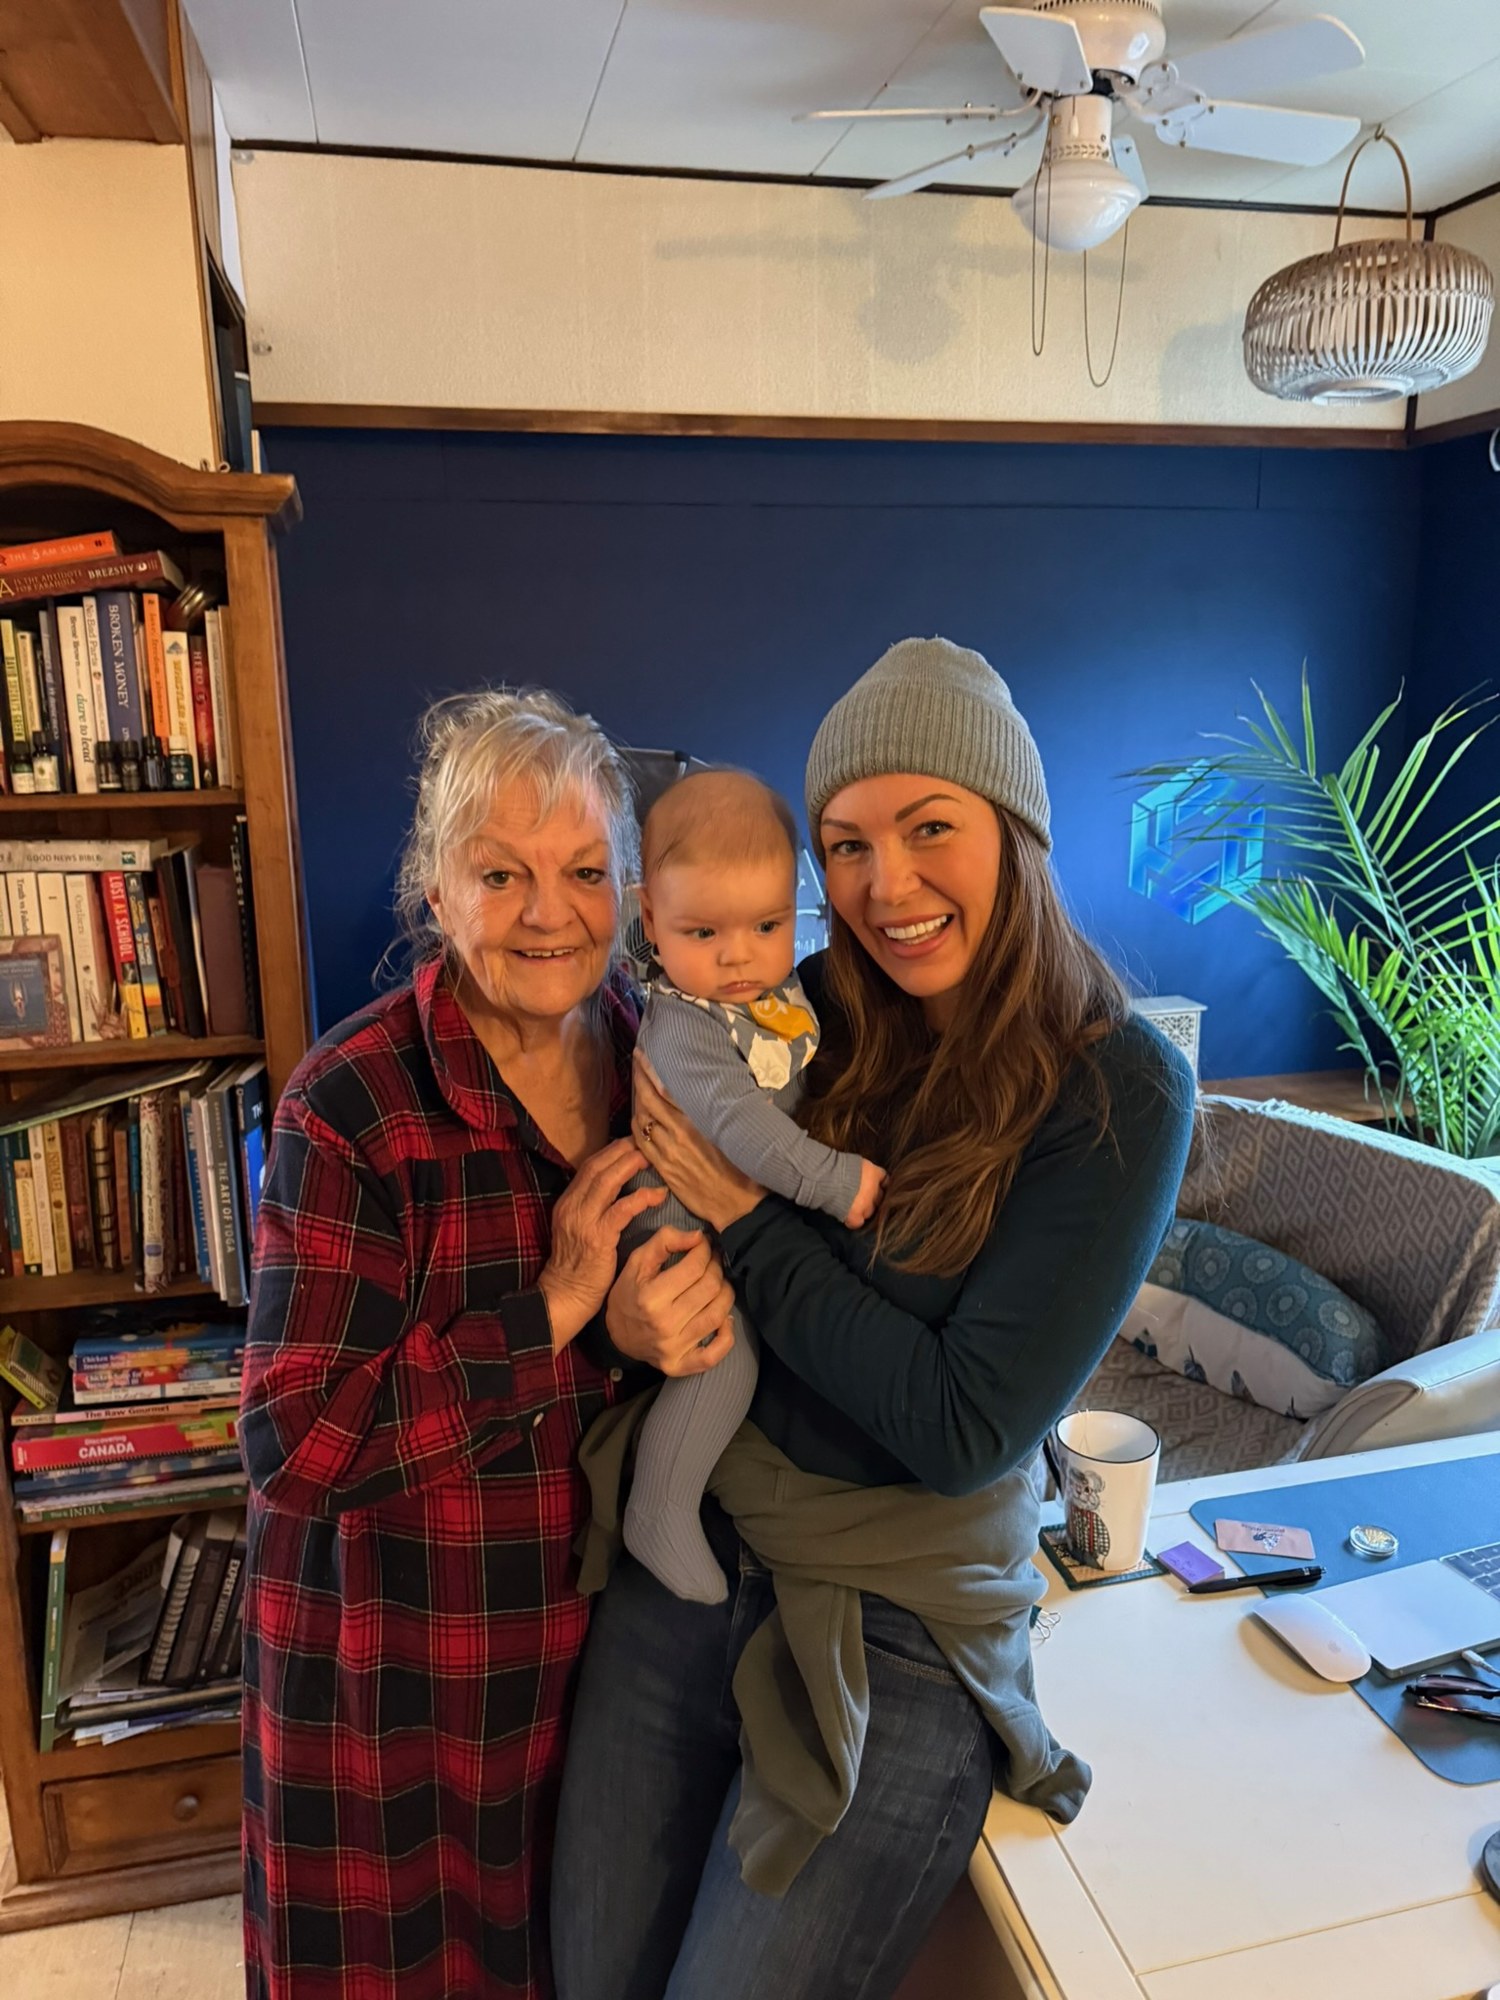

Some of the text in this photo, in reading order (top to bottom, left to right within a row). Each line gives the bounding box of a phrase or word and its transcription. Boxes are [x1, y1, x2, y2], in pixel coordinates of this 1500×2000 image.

[32, 548, 40, 560] 5
[61, 543, 85, 553] CLUB
[87, 619, 97, 638] Bad
[90, 641, 99, 667] Parts
[108, 605, 129, 708] BROKEN MONEY
[193, 651, 203, 685] HERO
[76, 694, 88, 722] dare
[79, 725, 89, 737] to
[81, 738, 94, 763] lead
[26, 854, 103, 862] GOOD NEWS BIBLE
[16, 878, 26, 900] Truth
[75, 894, 85, 935] Outliers
[109, 875, 132, 957] LOST AT SCHOOL
[218, 1162, 235, 1253] THE ART OF YOGA
[85, 1405, 170, 1419] The Raw Gourmet
[79, 1443, 135, 1459] CANADA
[85, 1435, 127, 1445] Discovering
[69, 1505, 105, 1518] INDIA
[222, 1558, 240, 1596] EXPERT
